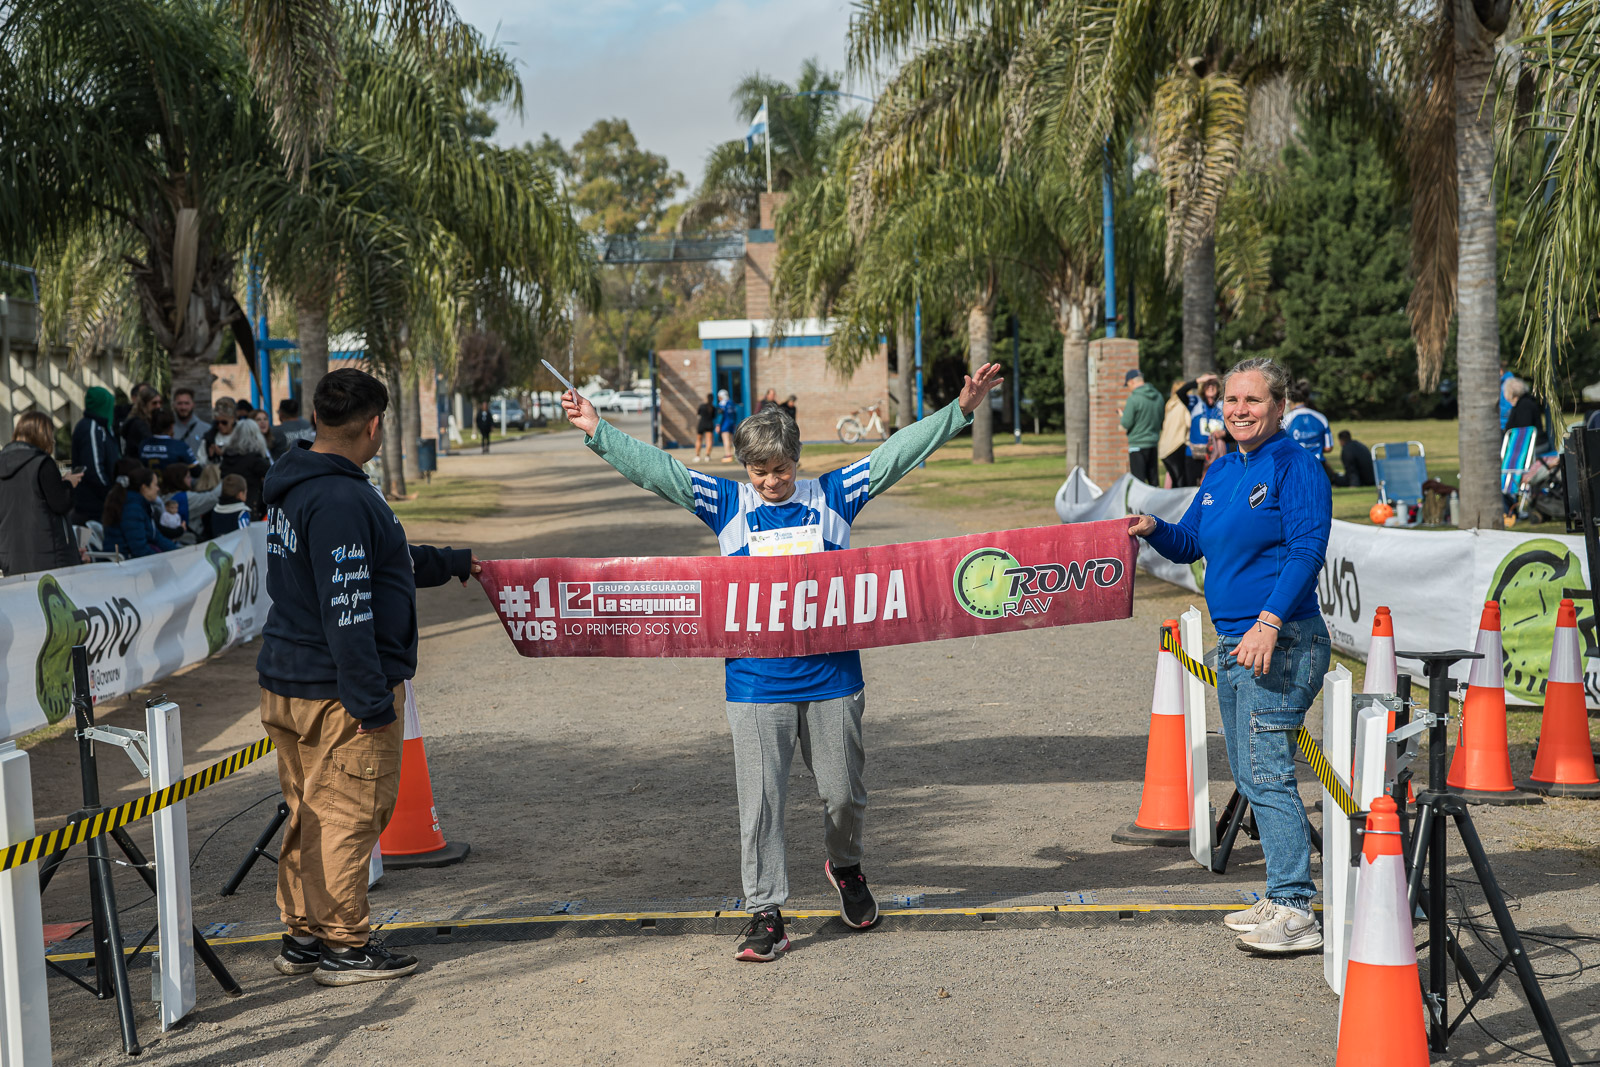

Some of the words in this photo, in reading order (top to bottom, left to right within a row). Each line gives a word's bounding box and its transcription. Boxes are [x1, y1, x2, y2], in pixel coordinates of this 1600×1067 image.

[332, 546, 347, 563] El
[597, 584, 631, 592] GRUPO
[633, 584, 696, 592] ASEGURADOR
[331, 592, 349, 607] más
[498, 577, 556, 618] #1
[620, 596, 696, 615] segunda
[725, 569, 908, 632] LLEGADA
[1002, 596, 1053, 618] RAV
[338, 610, 352, 627] del
[507, 620, 557, 641] VOS
[564, 623, 583, 635] LO
[587, 623, 642, 635] PRIMERO
[645, 622, 670, 635] SOS
[672, 622, 698, 635] VOS
